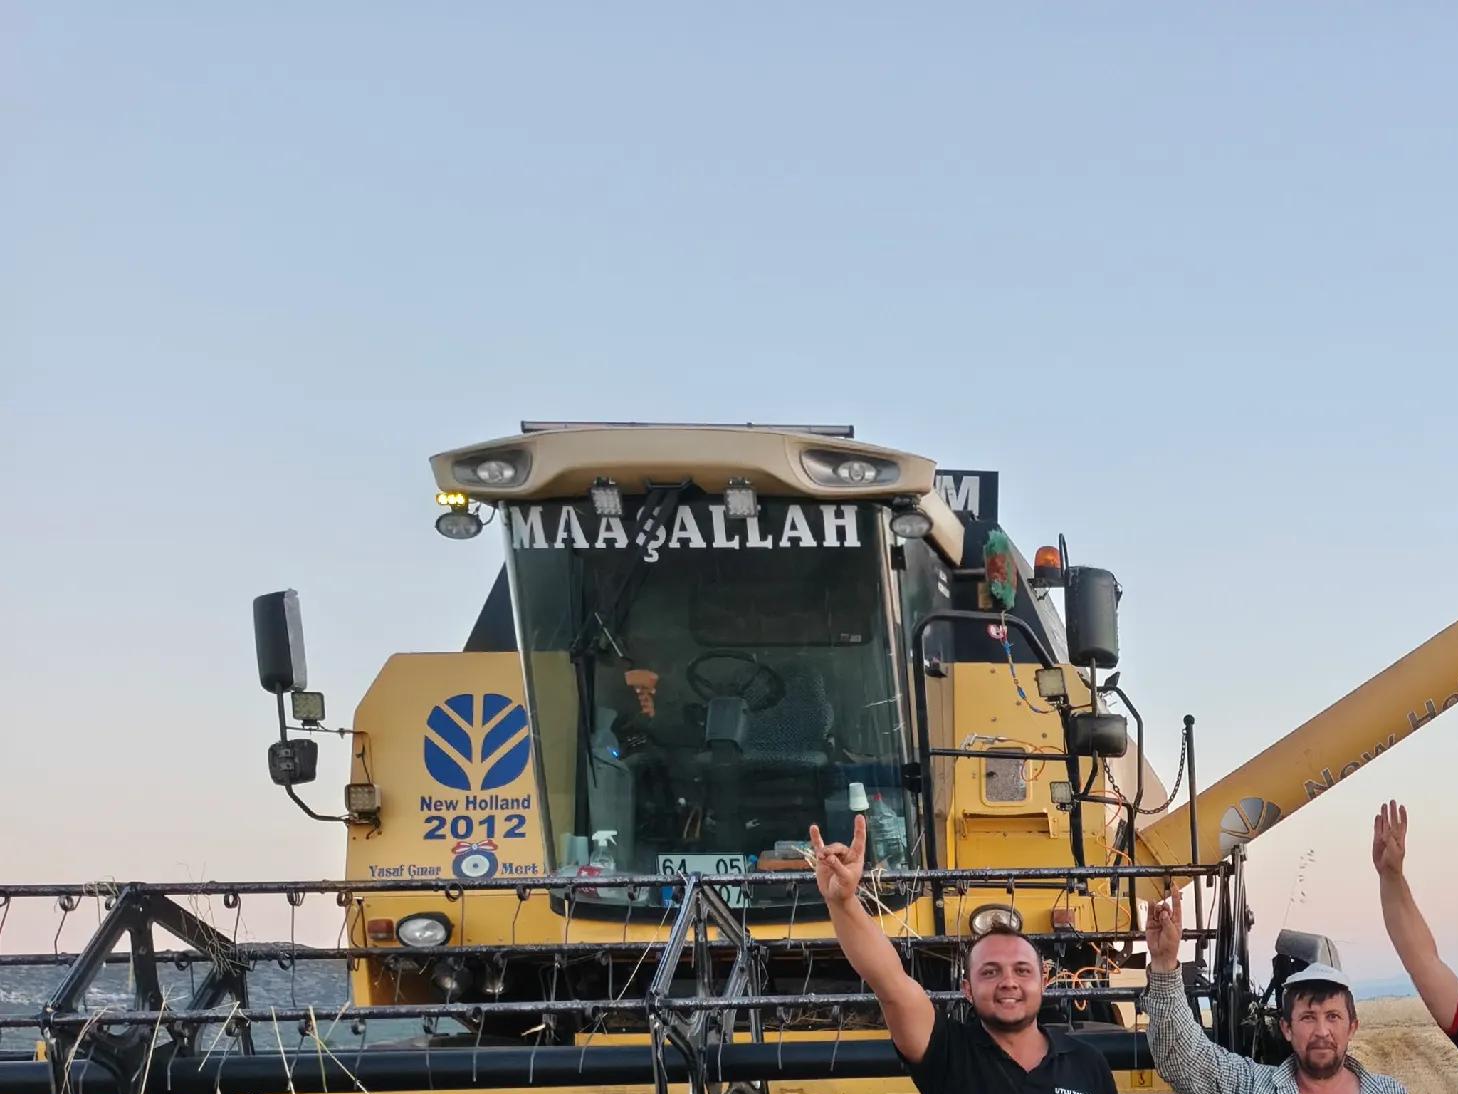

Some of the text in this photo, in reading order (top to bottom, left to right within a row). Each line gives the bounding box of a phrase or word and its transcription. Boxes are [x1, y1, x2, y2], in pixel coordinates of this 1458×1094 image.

[420, 794, 531, 812] New Holland
[423, 813, 527, 840] 2012
